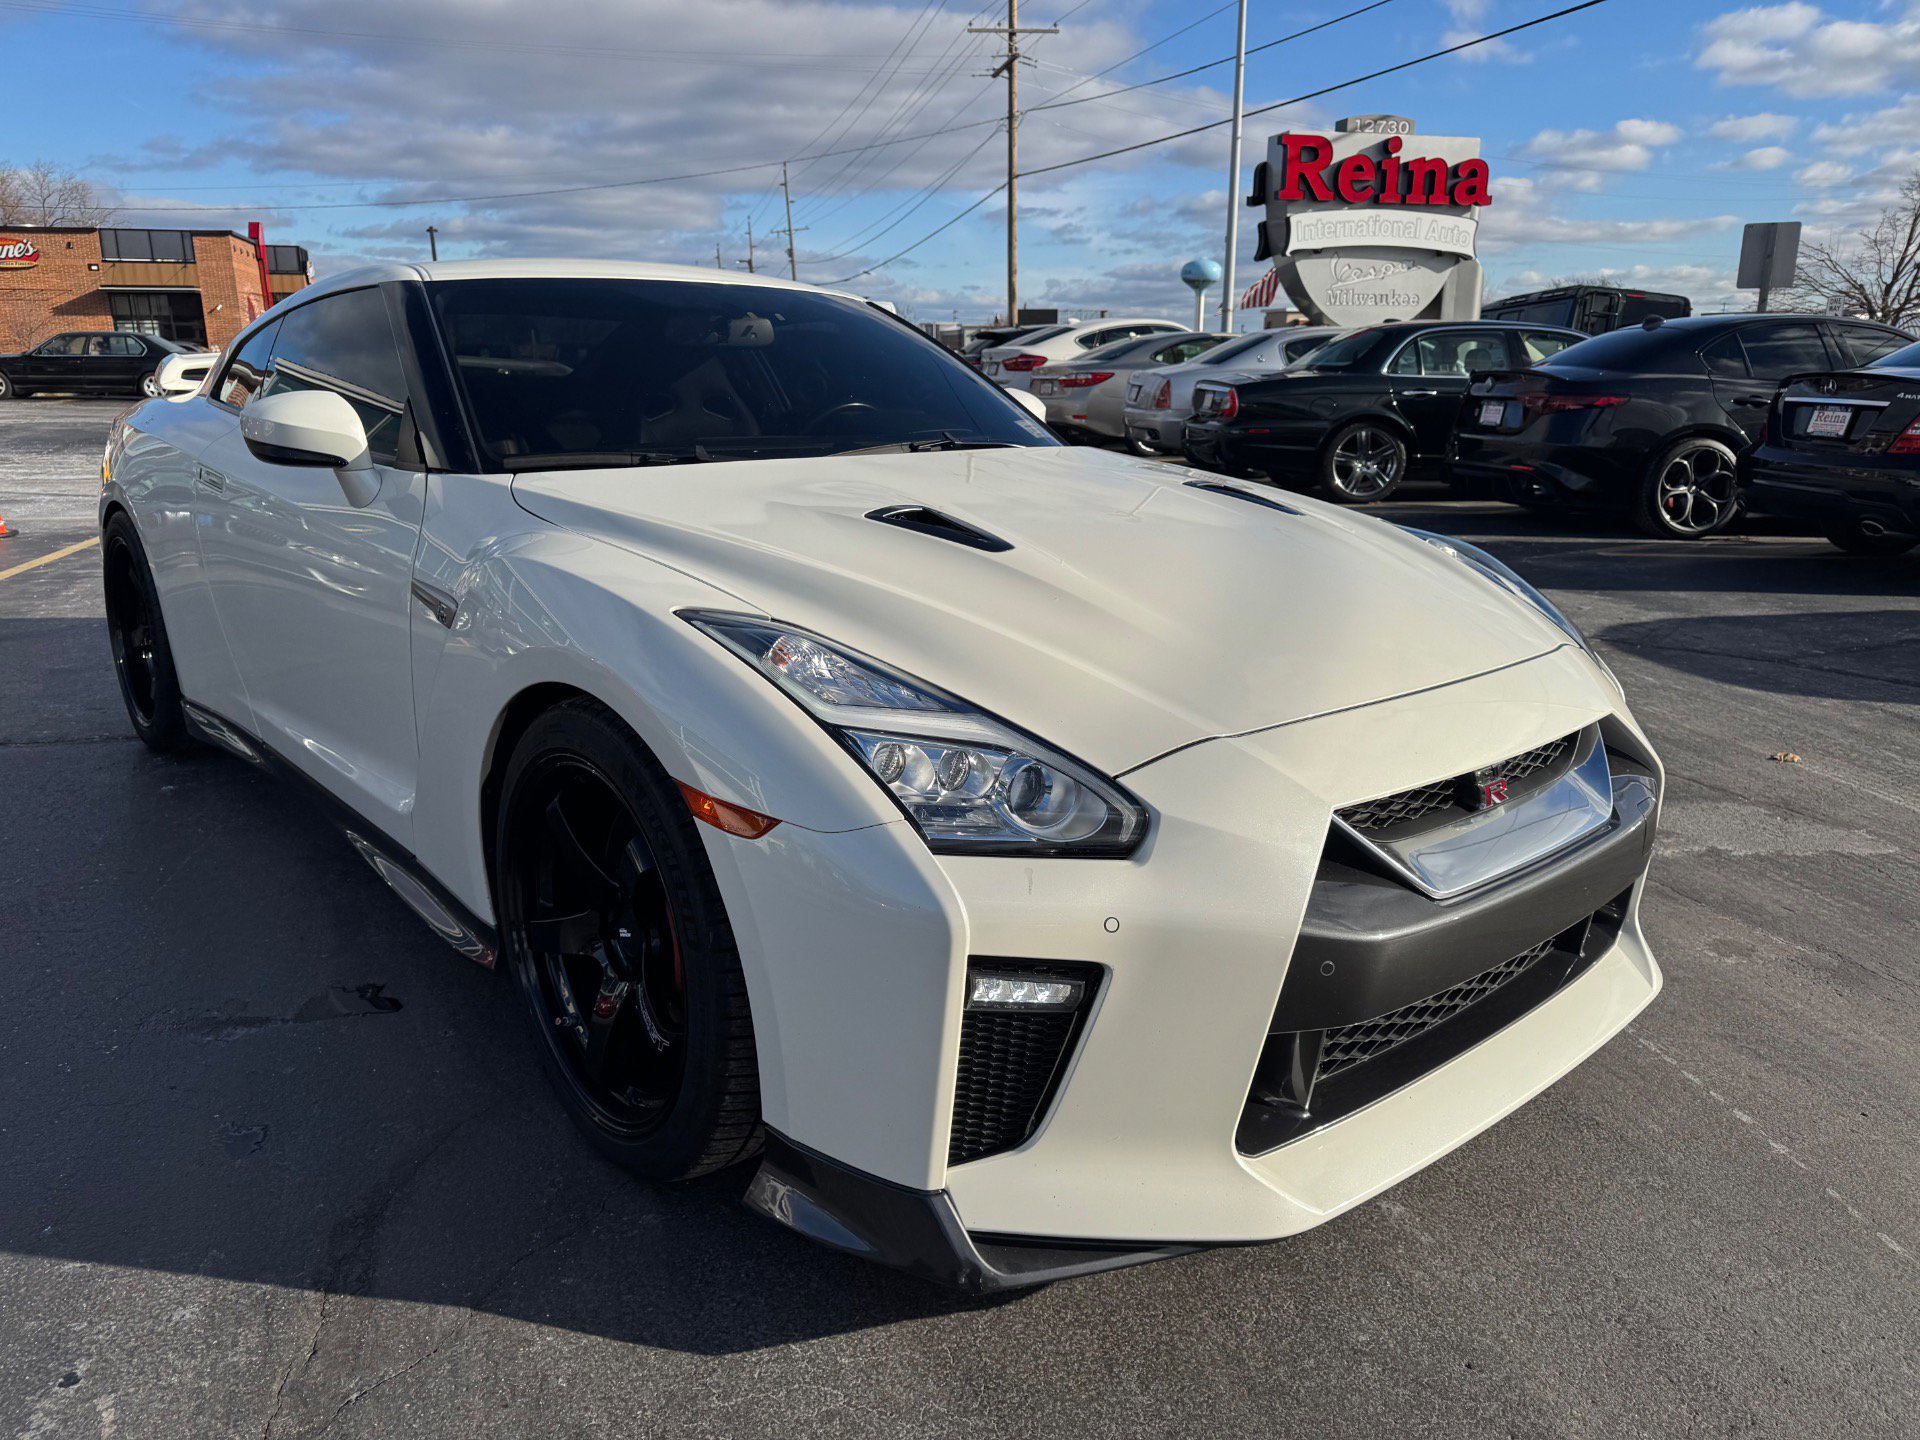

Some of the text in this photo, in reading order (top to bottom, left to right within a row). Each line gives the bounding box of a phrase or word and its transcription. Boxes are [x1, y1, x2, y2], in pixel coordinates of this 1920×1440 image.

[1355, 119, 1410, 134] 12730
[1278, 134, 1492, 207] Reina
[1296, 215, 1471, 248] International Auto
[0, 239, 37, 259] ne's
[1326, 288, 1420, 307] Milwaukee
[1829, 297, 1842, 305] ONE
[1814, 411, 1847, 424] Reina
